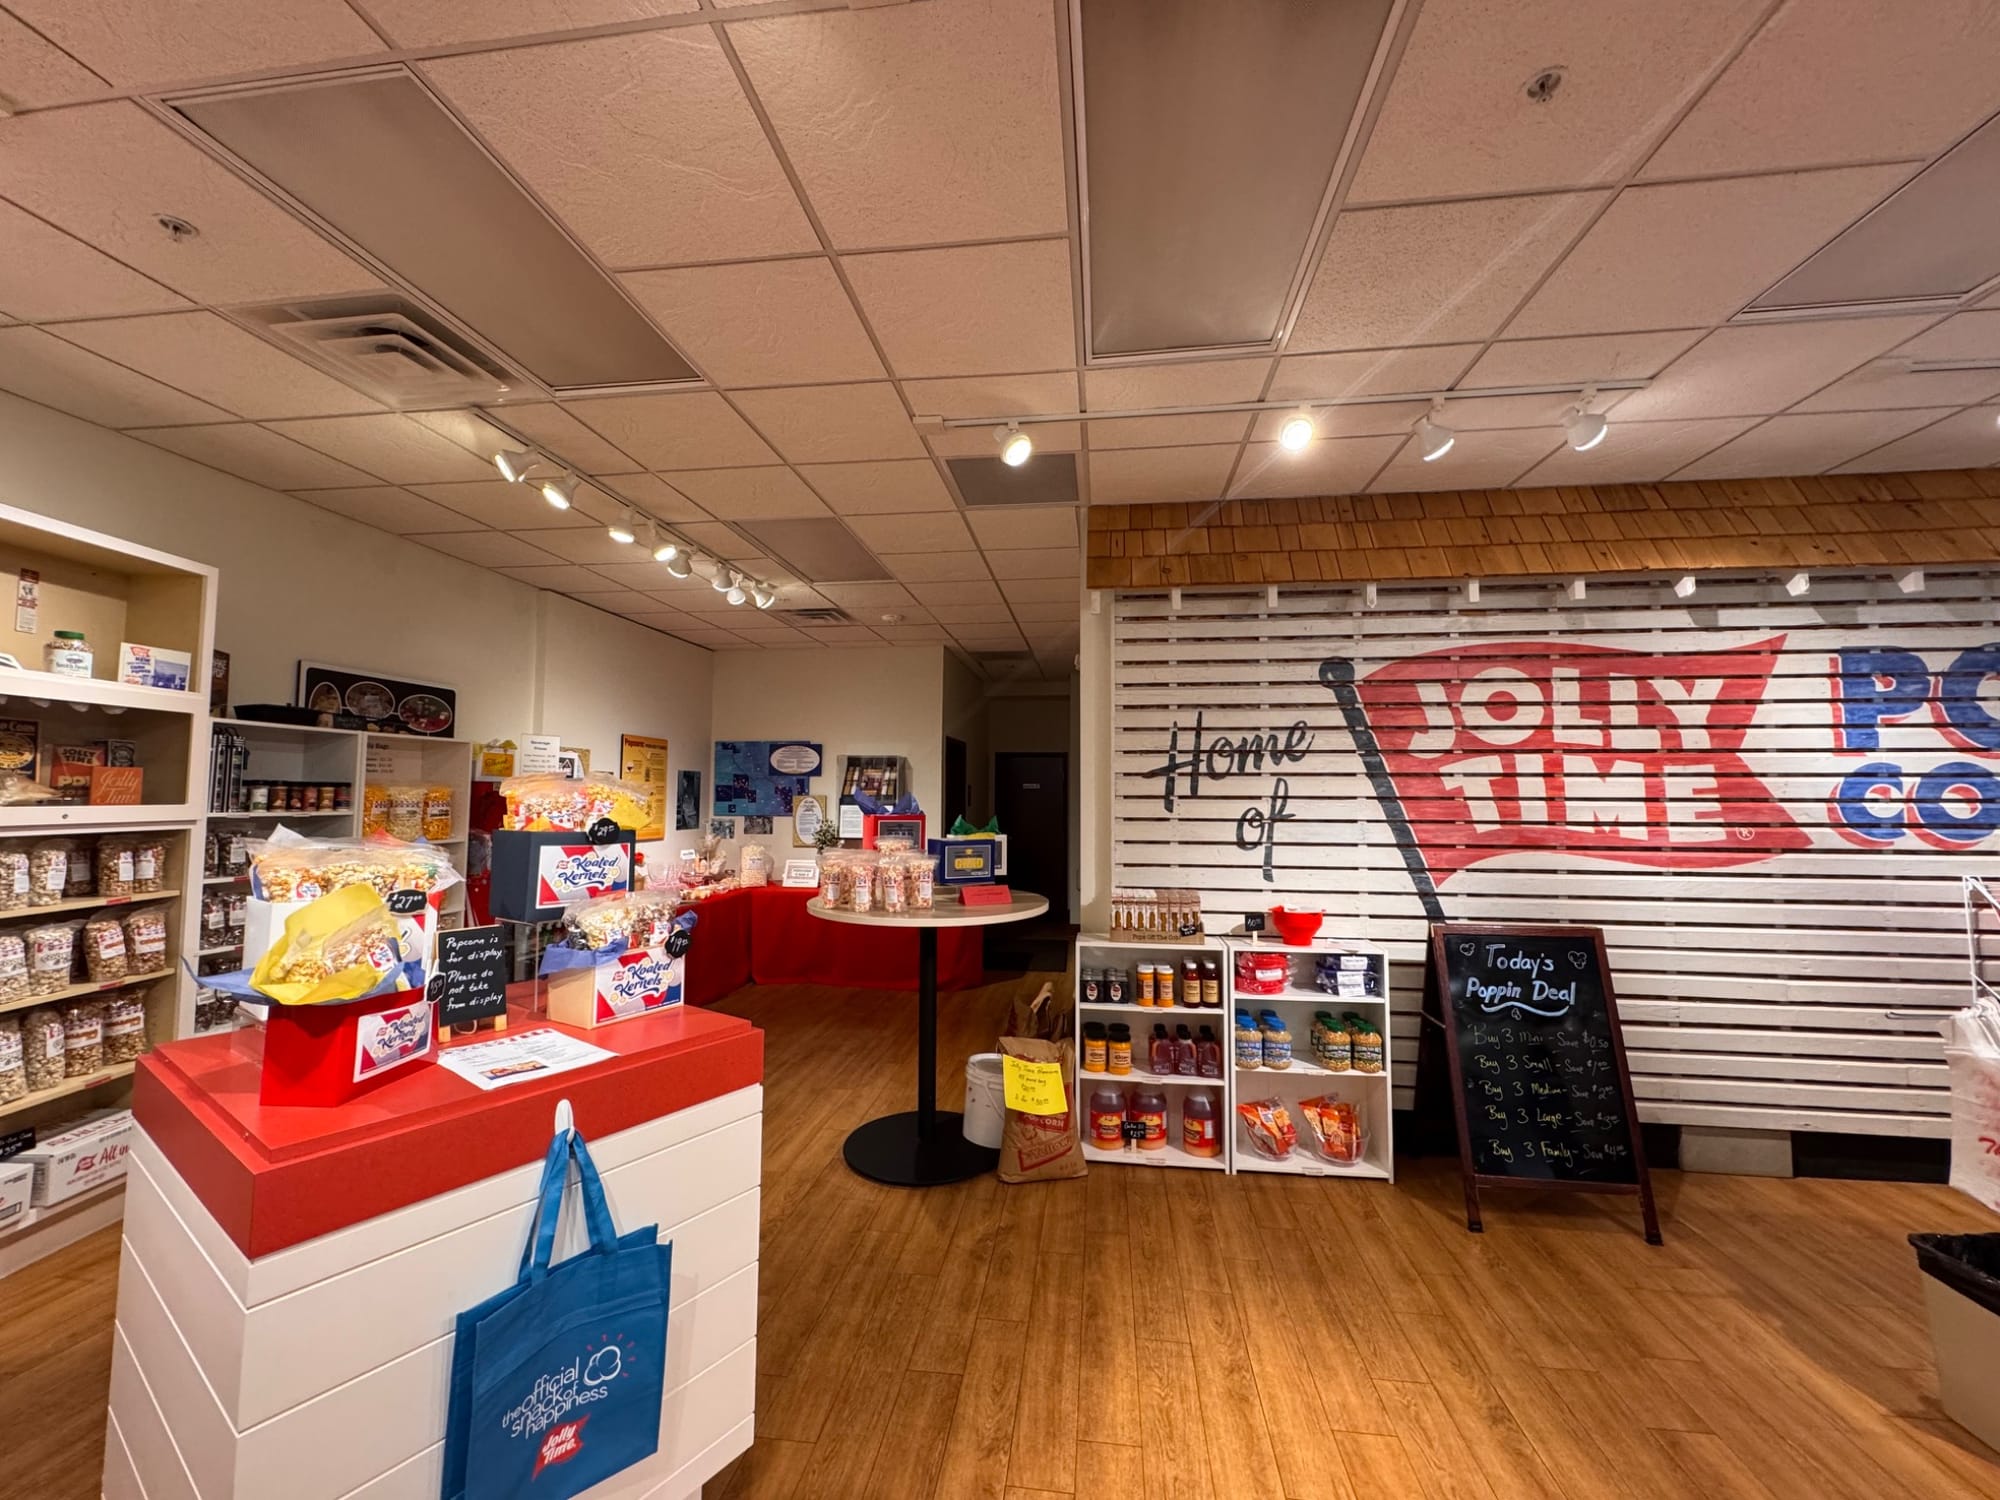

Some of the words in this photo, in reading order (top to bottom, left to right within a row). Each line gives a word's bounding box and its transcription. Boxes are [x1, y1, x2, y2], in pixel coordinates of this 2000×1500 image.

[1407, 667, 1723, 759] JOLLY
[62, 747, 96, 758] JOLLY
[64, 755, 95, 765] TIME
[1142, 711, 1315, 813] Home
[58, 775, 90, 787] PO
[100, 770, 139, 793] Jolly
[1438, 754, 1728, 842] TIME
[1236, 778, 1296, 883] of
[572, 856, 618, 872] Koated
[558, 867, 608, 885] Kernels
[446, 937, 485, 950] Popcorn
[490, 934, 499, 944] is
[446, 952, 463, 964] for
[468, 948, 503, 961] display
[1486, 944, 1554, 979] Today's
[448, 969, 477, 983] Please
[482, 969, 494, 978] do
[628, 960, 672, 979] Koated
[448, 983, 464, 995] not
[473, 983, 489, 993] take
[614, 974, 662, 997] Kernels
[1466, 977, 1522, 1004] Poppin
[1532, 980, 1576, 1005] Deal
[446, 998, 466, 1012] from
[469, 993, 503, 1006] display
[389, 1013, 425, 1033] Koated
[377, 1026, 418, 1050] Kernels
[1470, 1024, 1500, 1049] Buy
[1502, 1028, 1514, 1043] 3
[1557, 1031, 1579, 1048] Save
[1474, 1055, 1500, 1074] Buy
[1506, 1055, 1518, 1070] 3
[1523, 1055, 1552, 1071] Small
[1565, 1060, 1583, 1074] Save
[1479, 1080, 1504, 1101] Buy
[1513, 1081, 1524, 1096] 3
[1572, 1084, 1589, 1099] Save
[1485, 1105, 1508, 1131] Buy
[1517, 1108, 1529, 1124] 3
[1537, 1108, 1564, 1129] Large
[1575, 1112, 1594, 1127] Save
[99, 1144, 118, 1165] All
[1489, 1140, 1514, 1162] Buy
[1523, 1141, 1536, 1157] 3
[502, 1406, 522, 1429] the
[522, 1356, 579, 1412] official
[511, 1386, 563, 1438] snack
[563, 1380, 579, 1400] of
[525, 1386, 609, 1440] happiness
[542, 1424, 577, 1452] Jolly
[543, 1438, 576, 1466] Time
